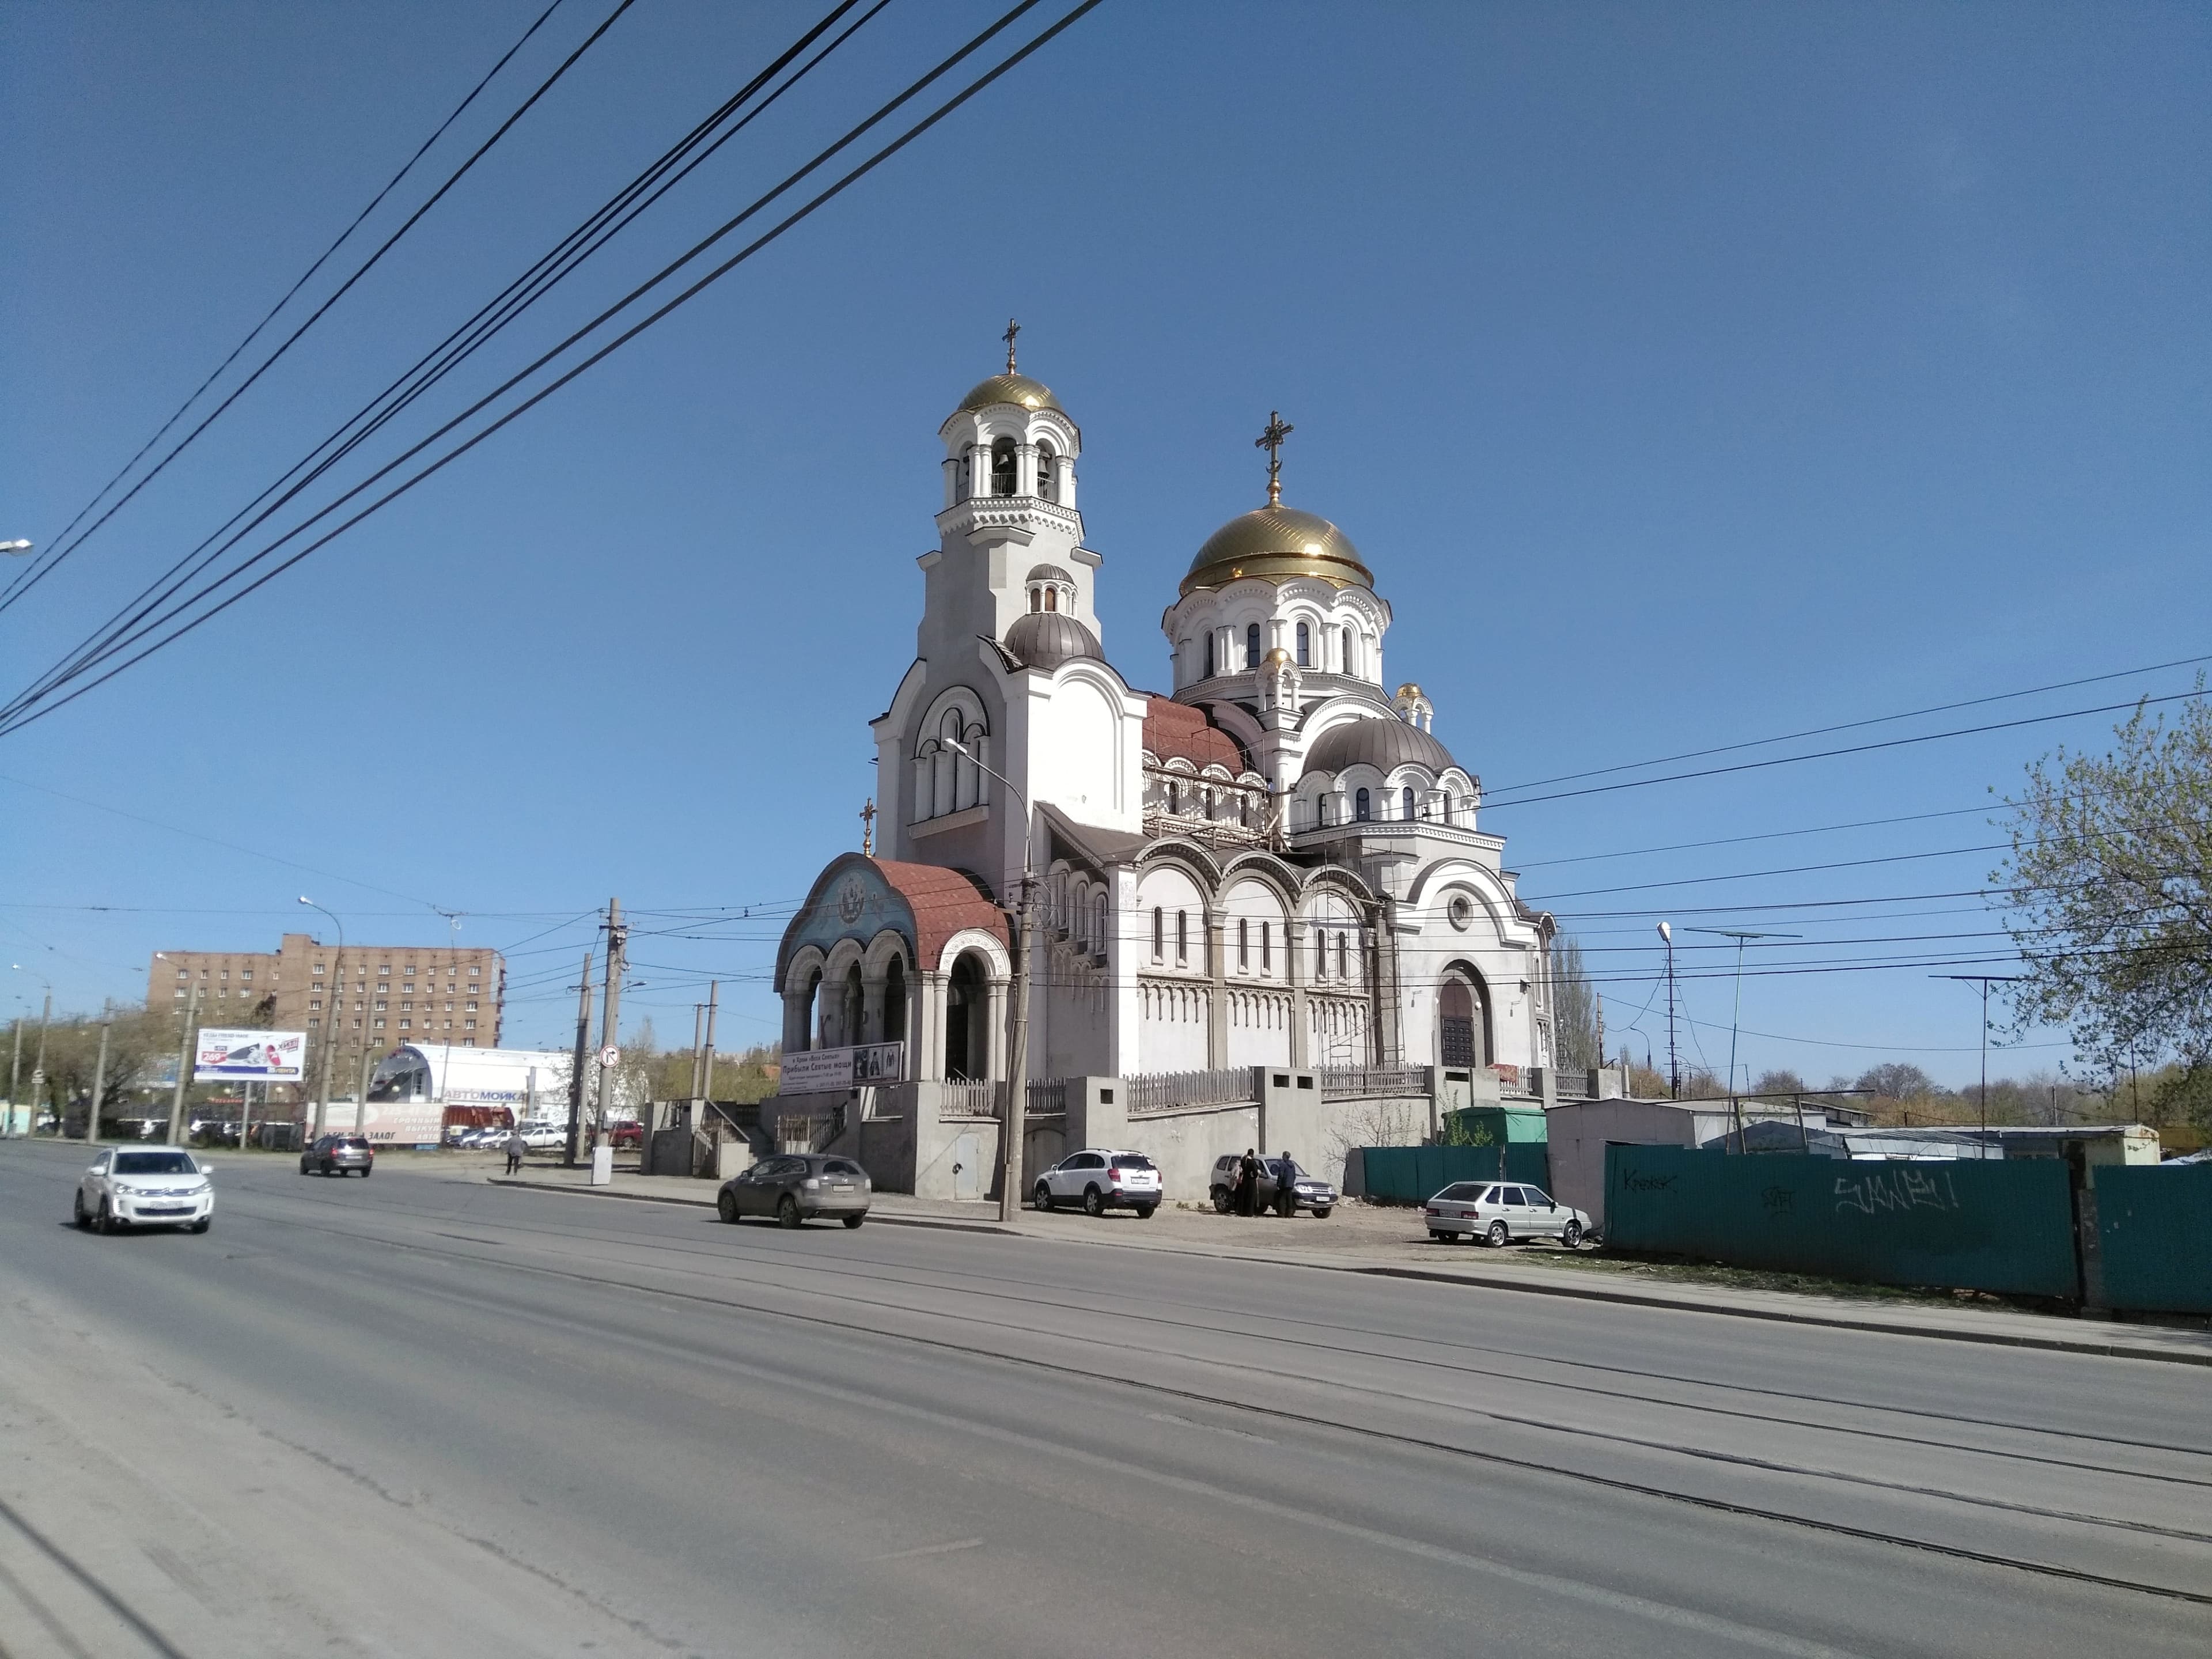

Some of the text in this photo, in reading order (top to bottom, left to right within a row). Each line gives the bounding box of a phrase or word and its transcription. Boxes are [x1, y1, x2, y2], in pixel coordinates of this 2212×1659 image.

[203, 1052, 221, 1061] 269
[783, 1061, 852, 1075] Прибыли Святые мощи
[444, 1089, 525, 1101] АВТОМОЙКА
[368, 1131, 396, 1140] ЗАЛОГ
